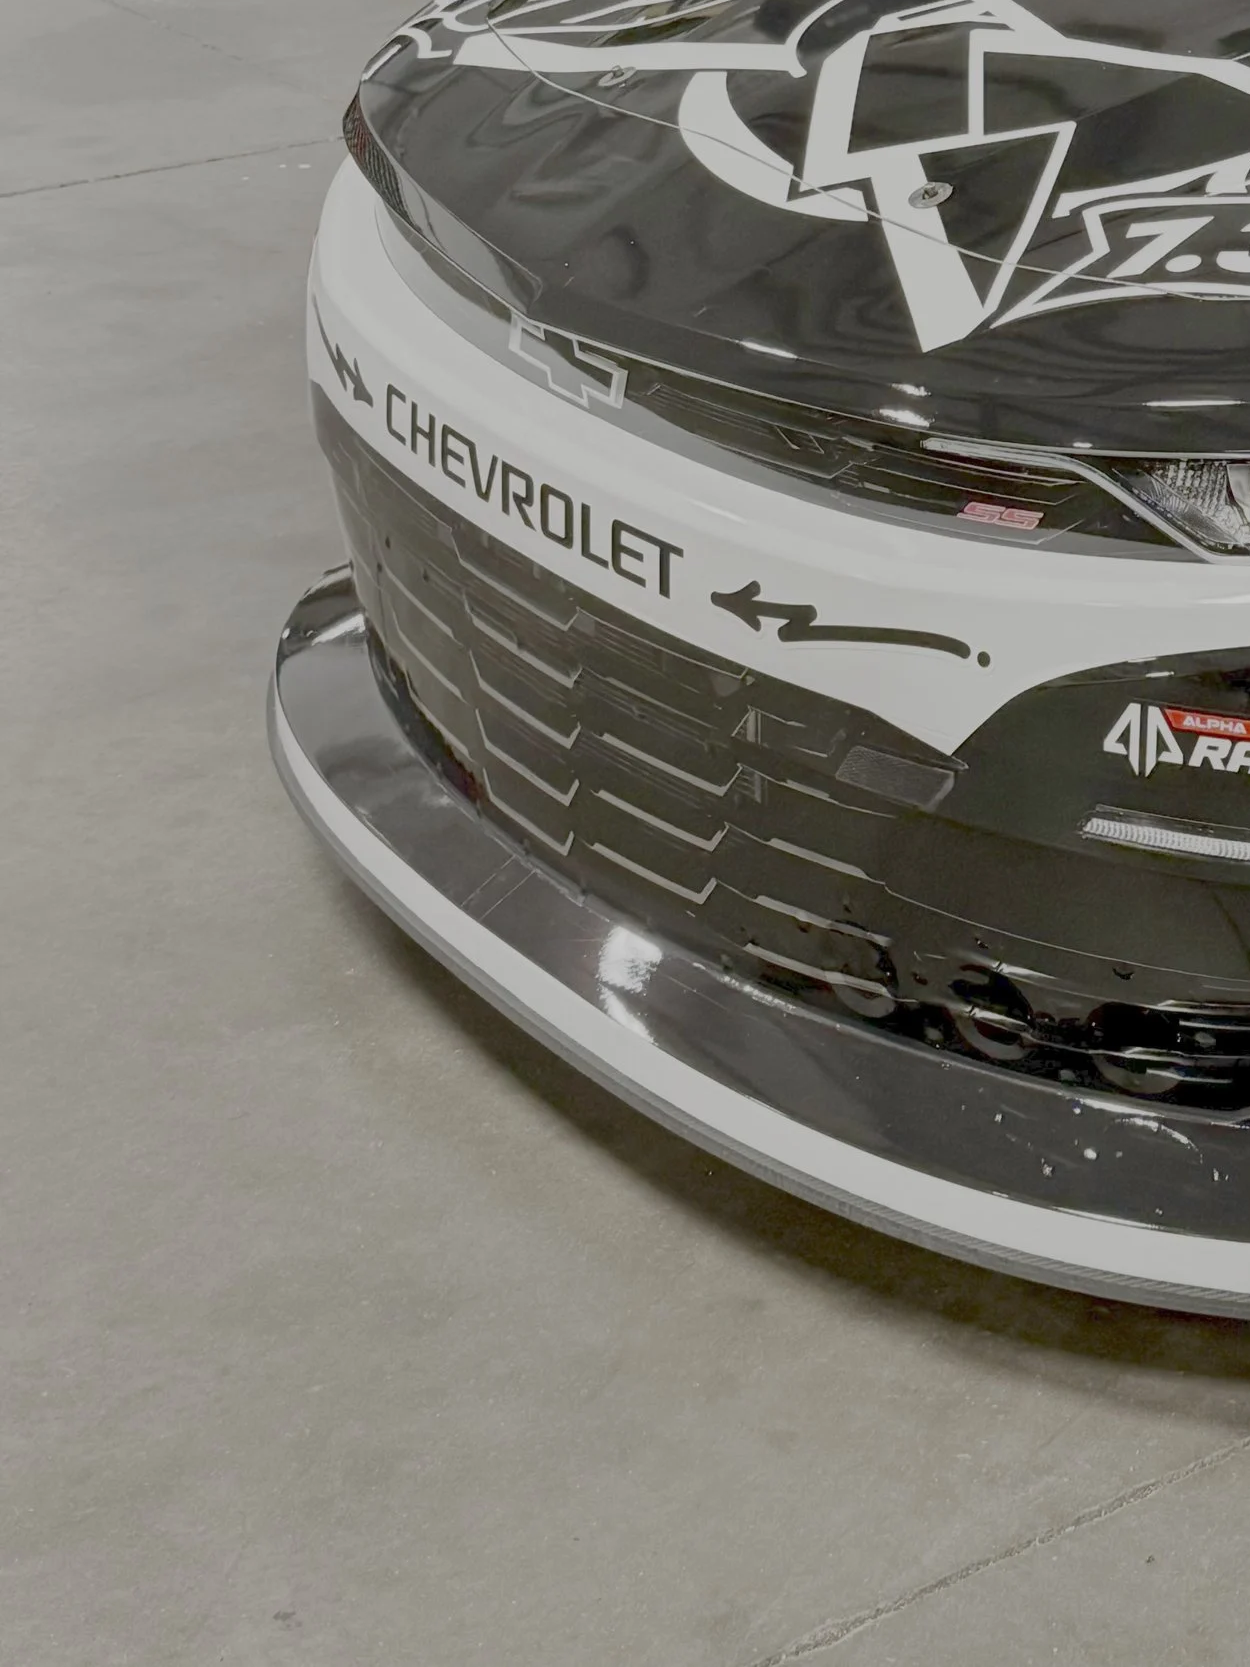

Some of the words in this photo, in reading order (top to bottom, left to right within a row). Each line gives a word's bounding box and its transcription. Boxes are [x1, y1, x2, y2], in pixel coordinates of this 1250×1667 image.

[385, 382, 684, 599] CHEVROLET
[957, 500, 1044, 530] SS
[1182, 715, 1246, 735] ALPHA
